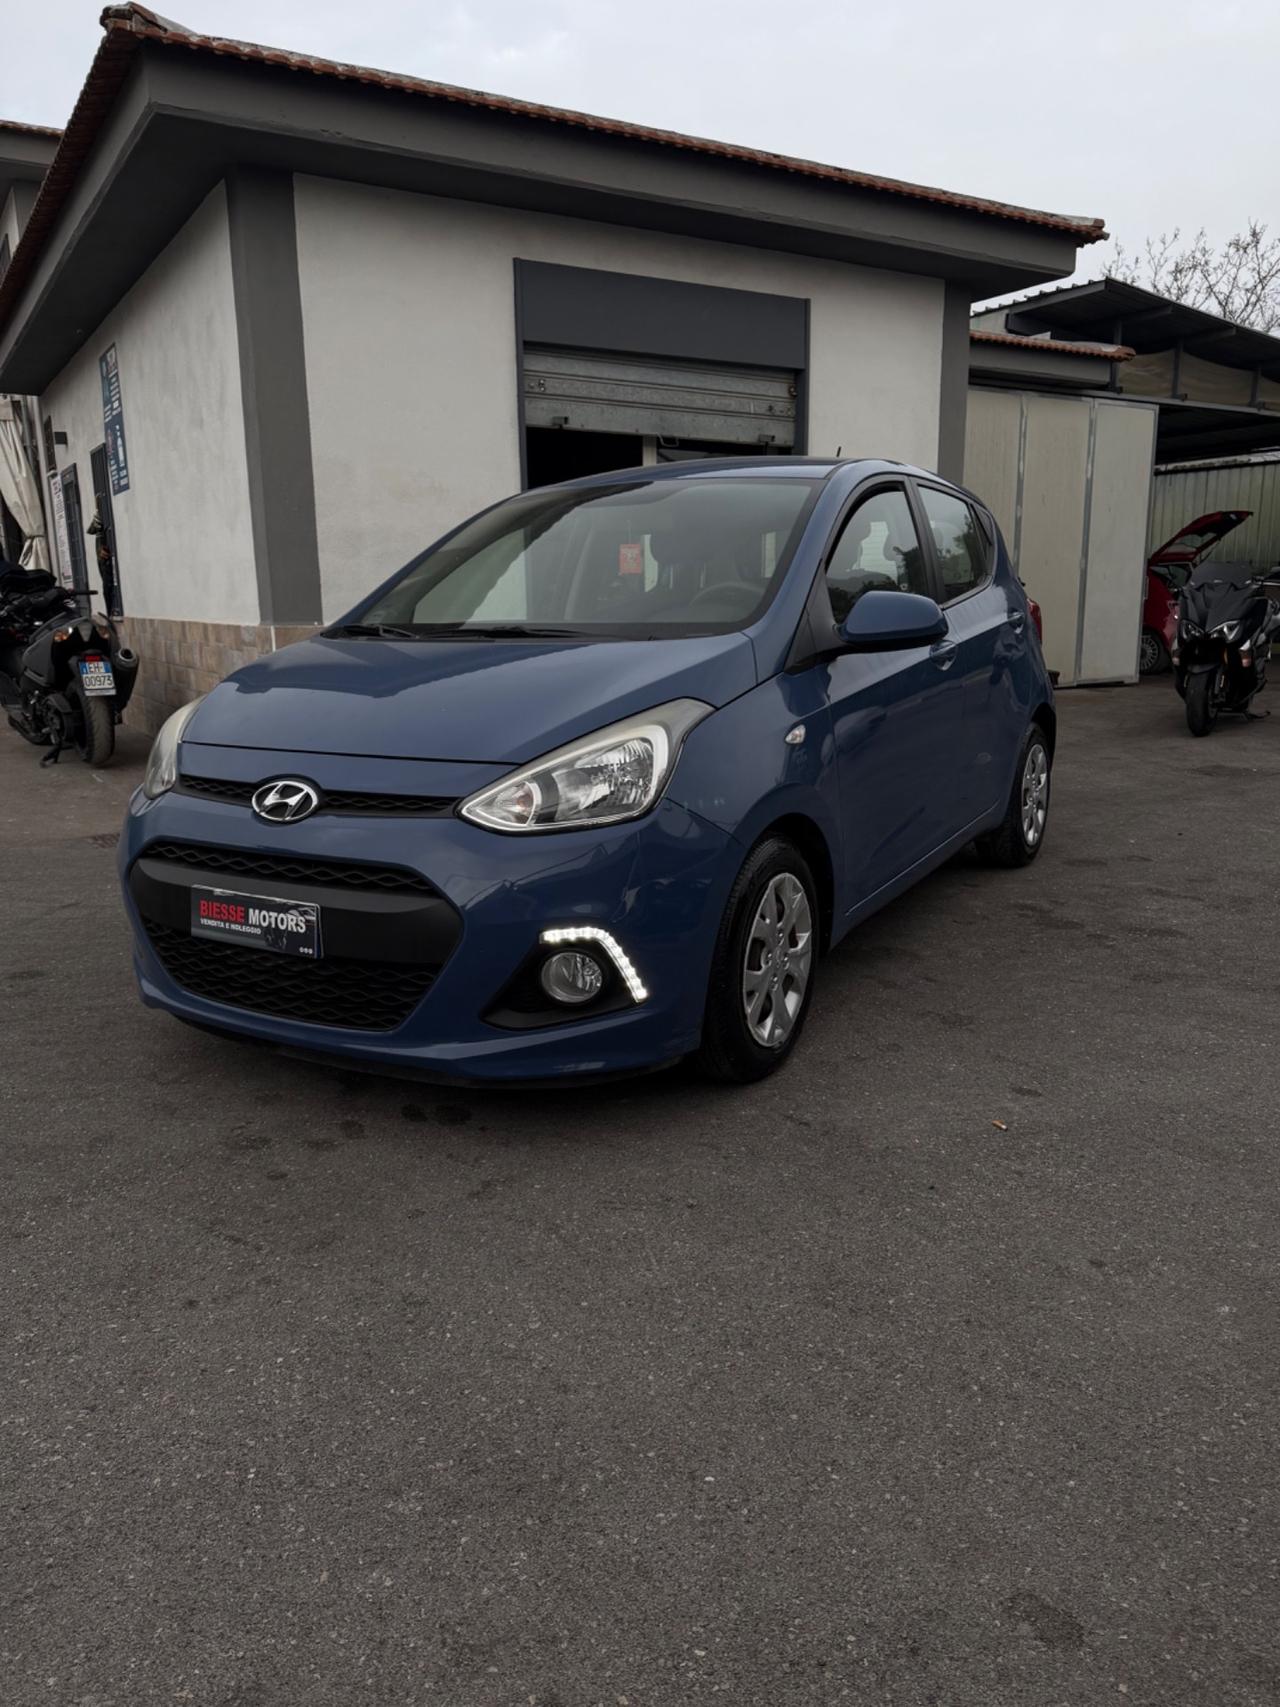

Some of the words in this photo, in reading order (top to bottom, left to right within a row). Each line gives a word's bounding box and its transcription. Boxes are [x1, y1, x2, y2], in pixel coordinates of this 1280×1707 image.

[85, 675, 112, 686] 00973
[200, 900, 245, 922] BIESSE
[249, 908, 306, 933] MOTORS
[200, 918, 224, 928] VENDITA
[231, 924, 261, 934] NOLEGGIO
